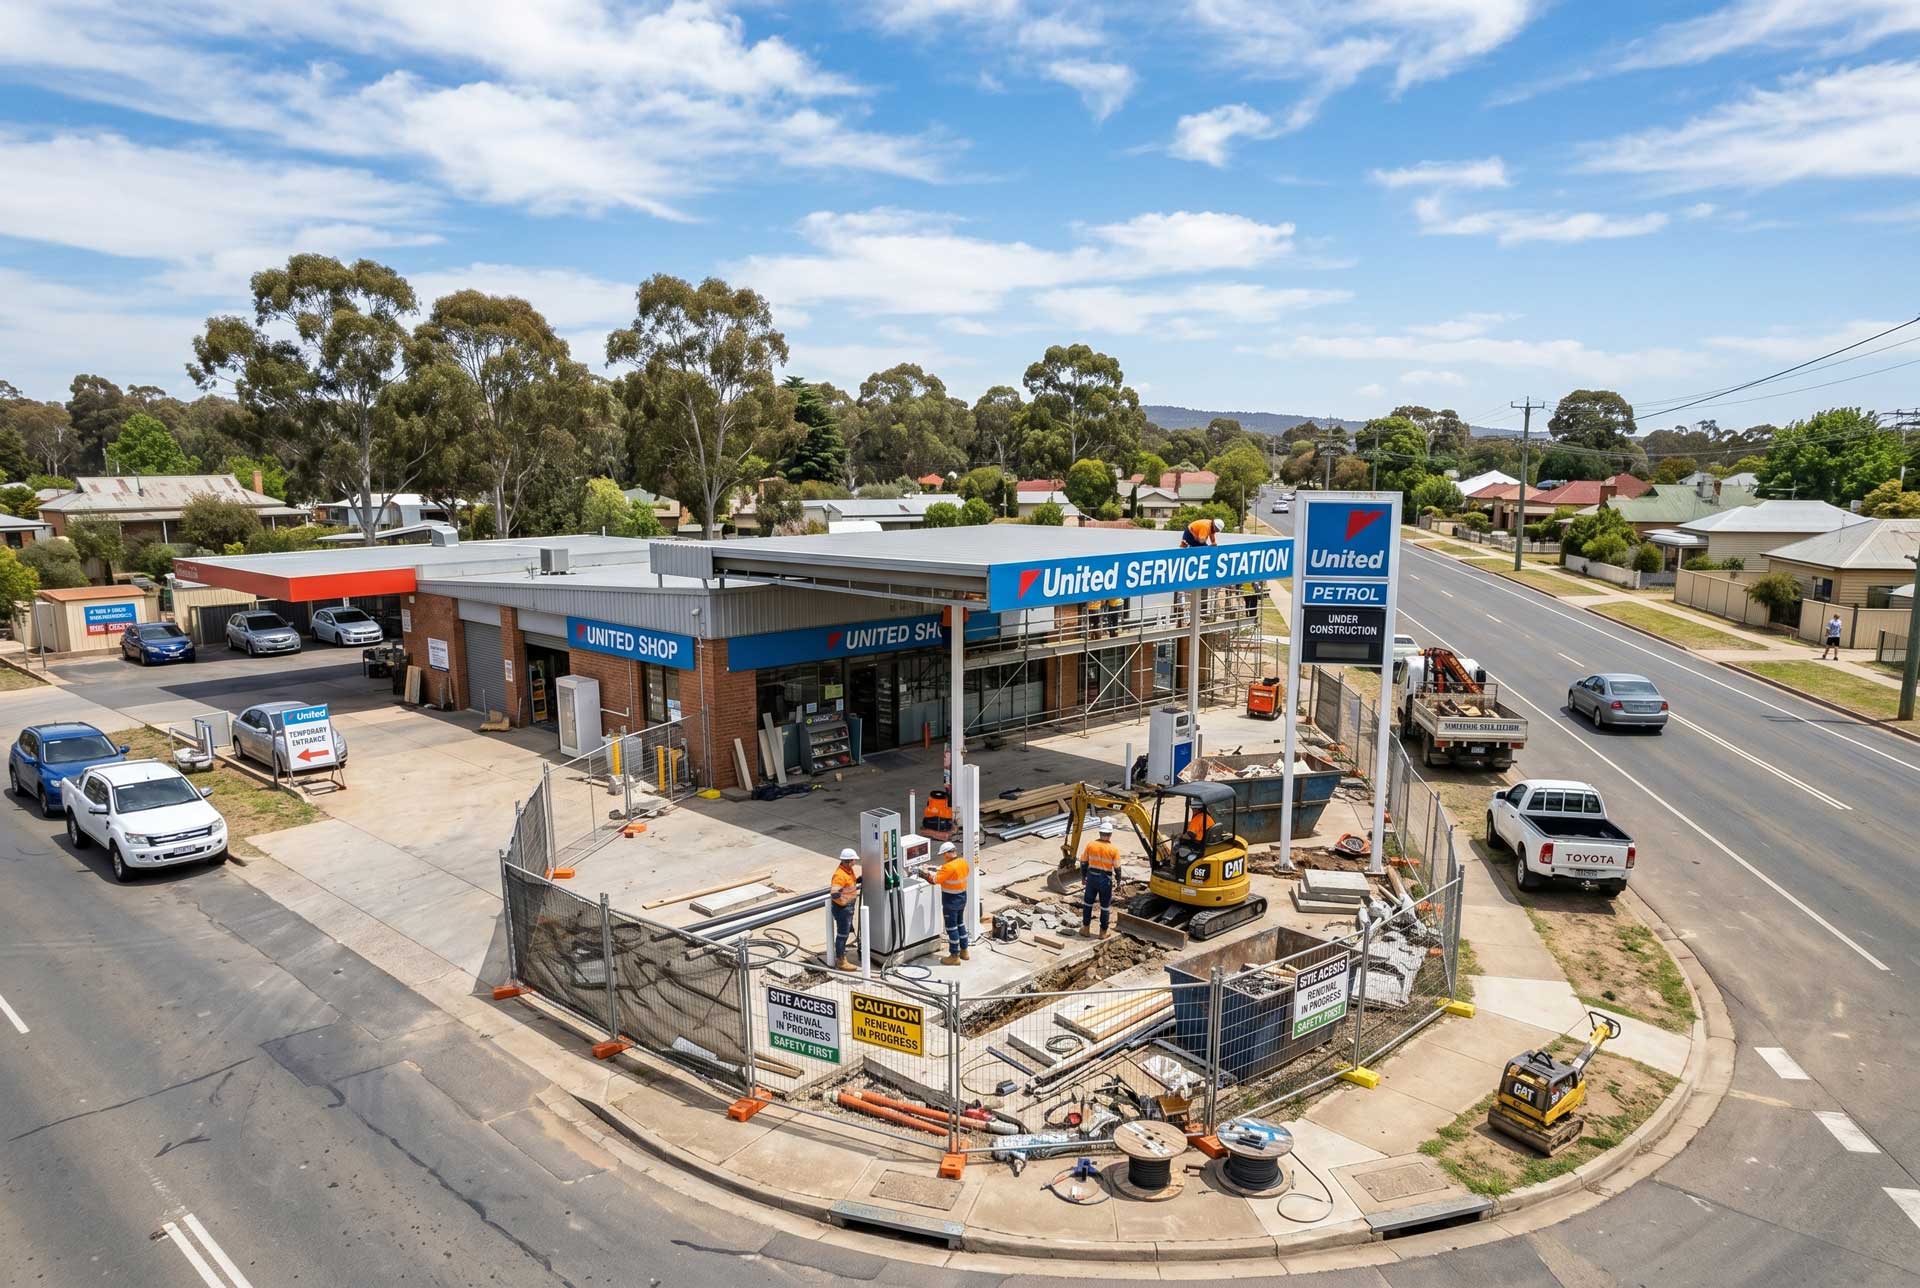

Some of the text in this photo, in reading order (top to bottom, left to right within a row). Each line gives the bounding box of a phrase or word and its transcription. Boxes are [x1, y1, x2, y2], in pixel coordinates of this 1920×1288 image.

[1310, 549, 1384, 569] United
[1043, 548, 1290, 598] United SERVICE STATION
[1312, 587, 1379, 601] PETROL
[1328, 614, 1358, 624] UNDER
[846, 624, 910, 650] UNITED
[1309, 624, 1378, 636] CONSTRUCTION
[586, 626, 678, 660] UNITED SHOP
[296, 709, 326, 720] United
[1225, 858, 1244, 878] CAT
[1566, 854, 1614, 864] TOYOTA
[770, 990, 834, 1016] SITE ACCESS
[854, 998, 920, 1022] CAUTION
[1301, 1004, 1309, 1014] IN
[782, 1010, 822, 1029] RENEWAL
[864, 1017, 908, 1036] RENEWAL
[1297, 1014, 1324, 1033] SAFETY
[776, 1020, 831, 1042] IN PROGRESS
[857, 1026, 918, 1050] IN PROGRESS
[774, 1035, 833, 1060] SAFETY FIRST
[1514, 1082, 1535, 1102] CAT
